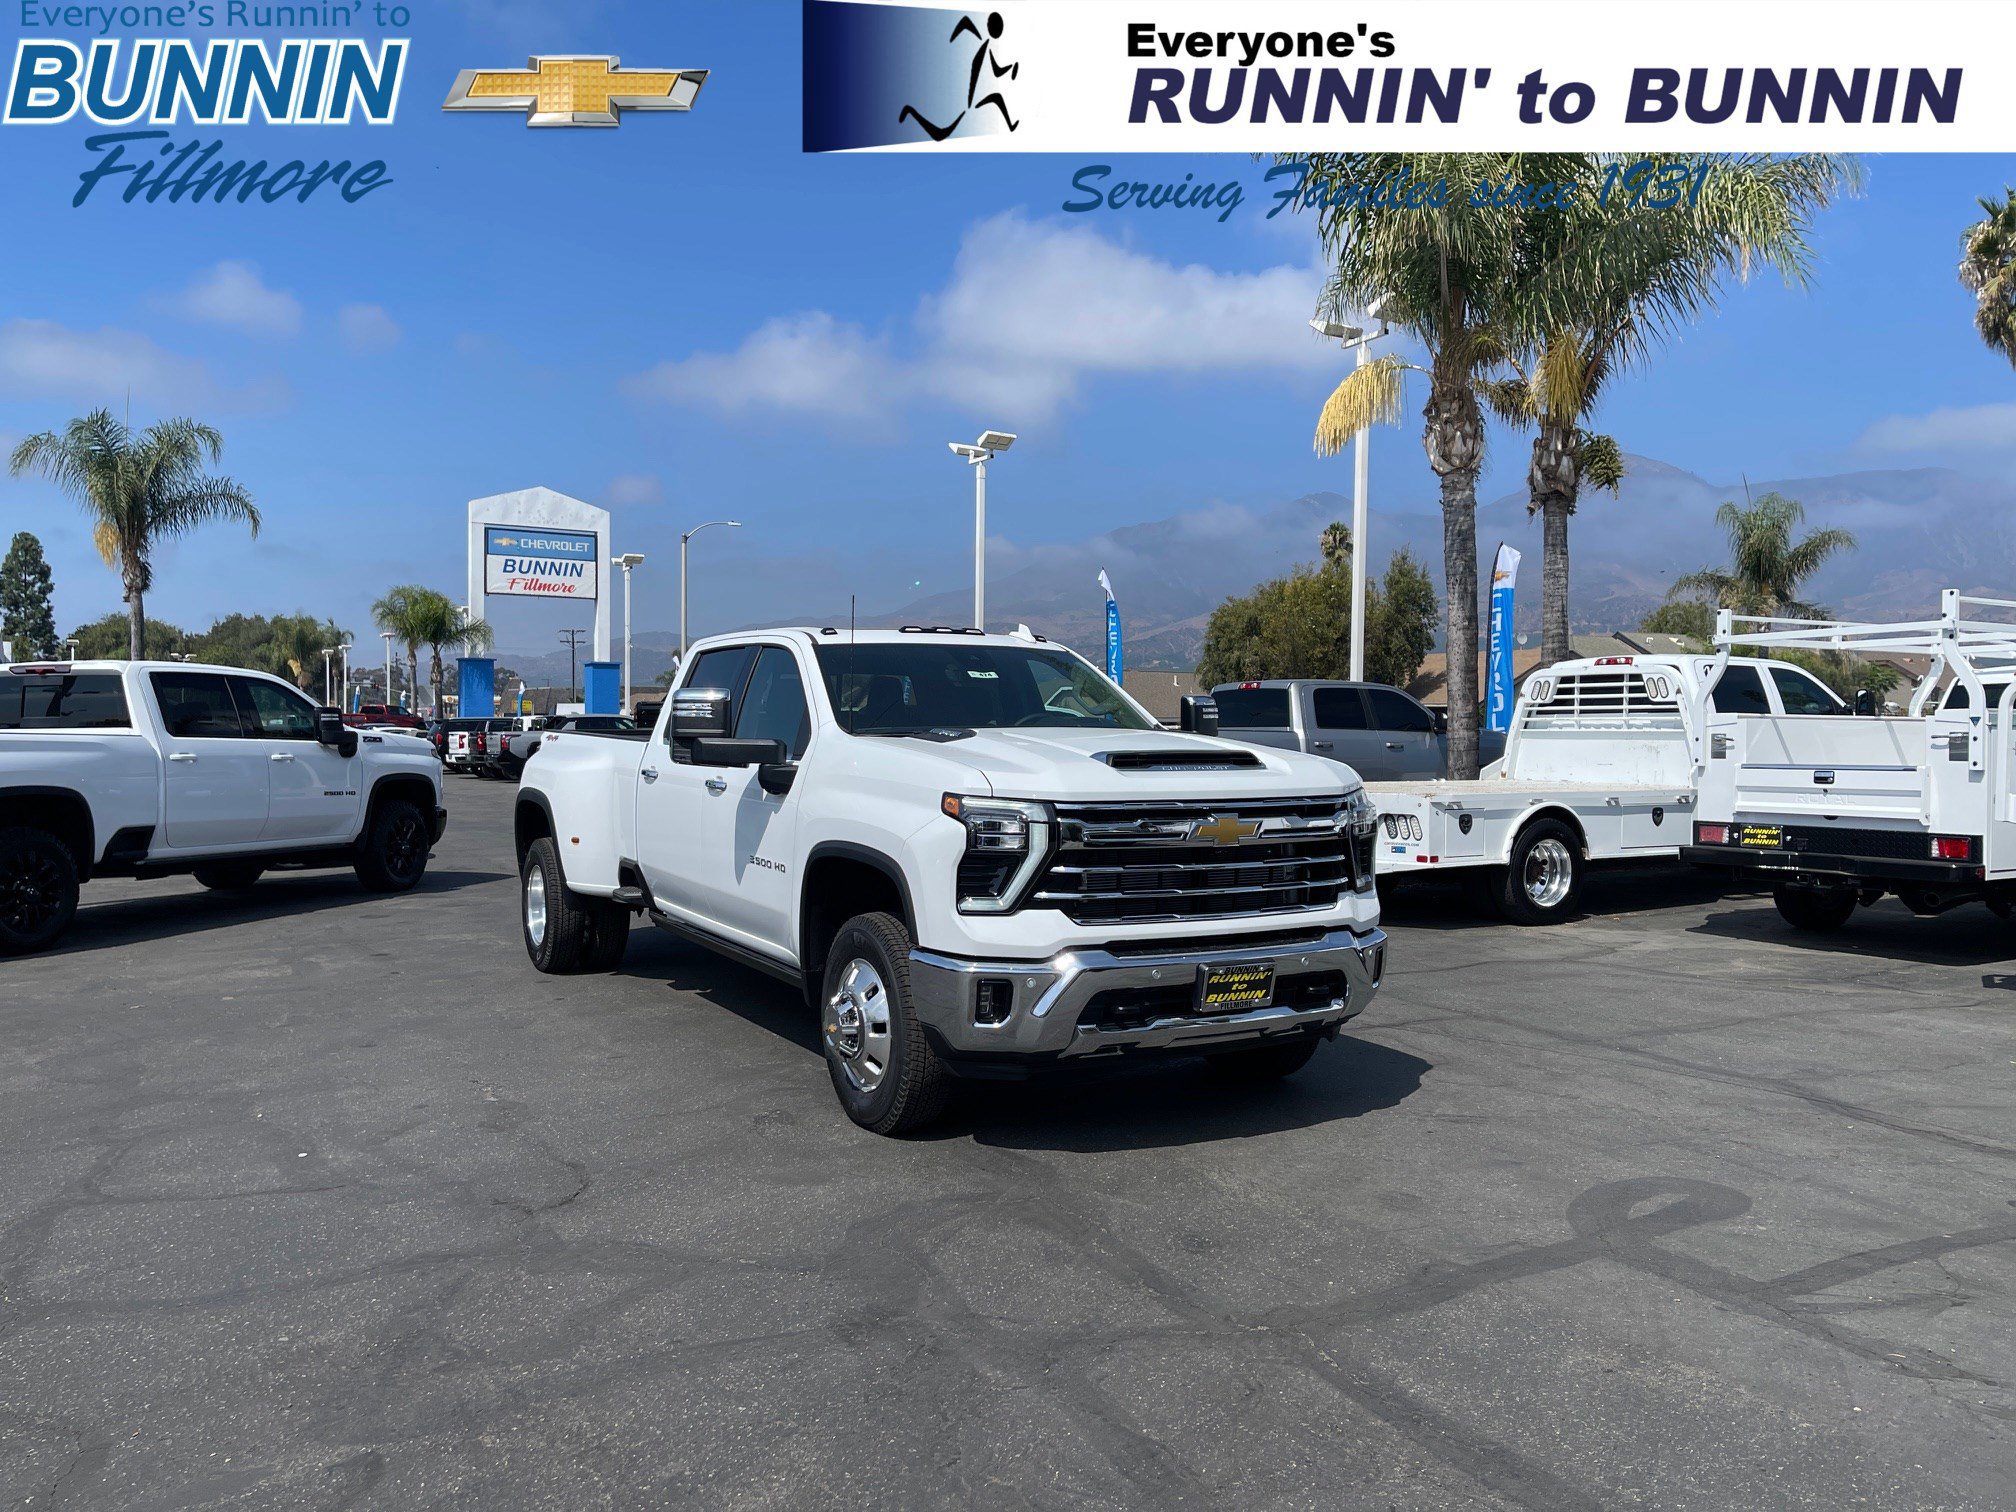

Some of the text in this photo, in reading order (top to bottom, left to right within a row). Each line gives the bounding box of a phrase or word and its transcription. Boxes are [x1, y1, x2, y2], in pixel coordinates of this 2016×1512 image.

[520, 538, 590, 552] CHEVROLET
[502, 558, 584, 578] BUNNIN
[507, 577, 576, 594] Fillmore
[1743, 837, 1780, 845] BUNNIN
[774, 861, 786, 873] HD
[1208, 971, 1272, 984] RUNNIN'
[1231, 983, 1248, 991] to
[1205, 989, 1267, 1003] BUNNIN
[1220, 1001, 1253, 1009] FILLMORE
